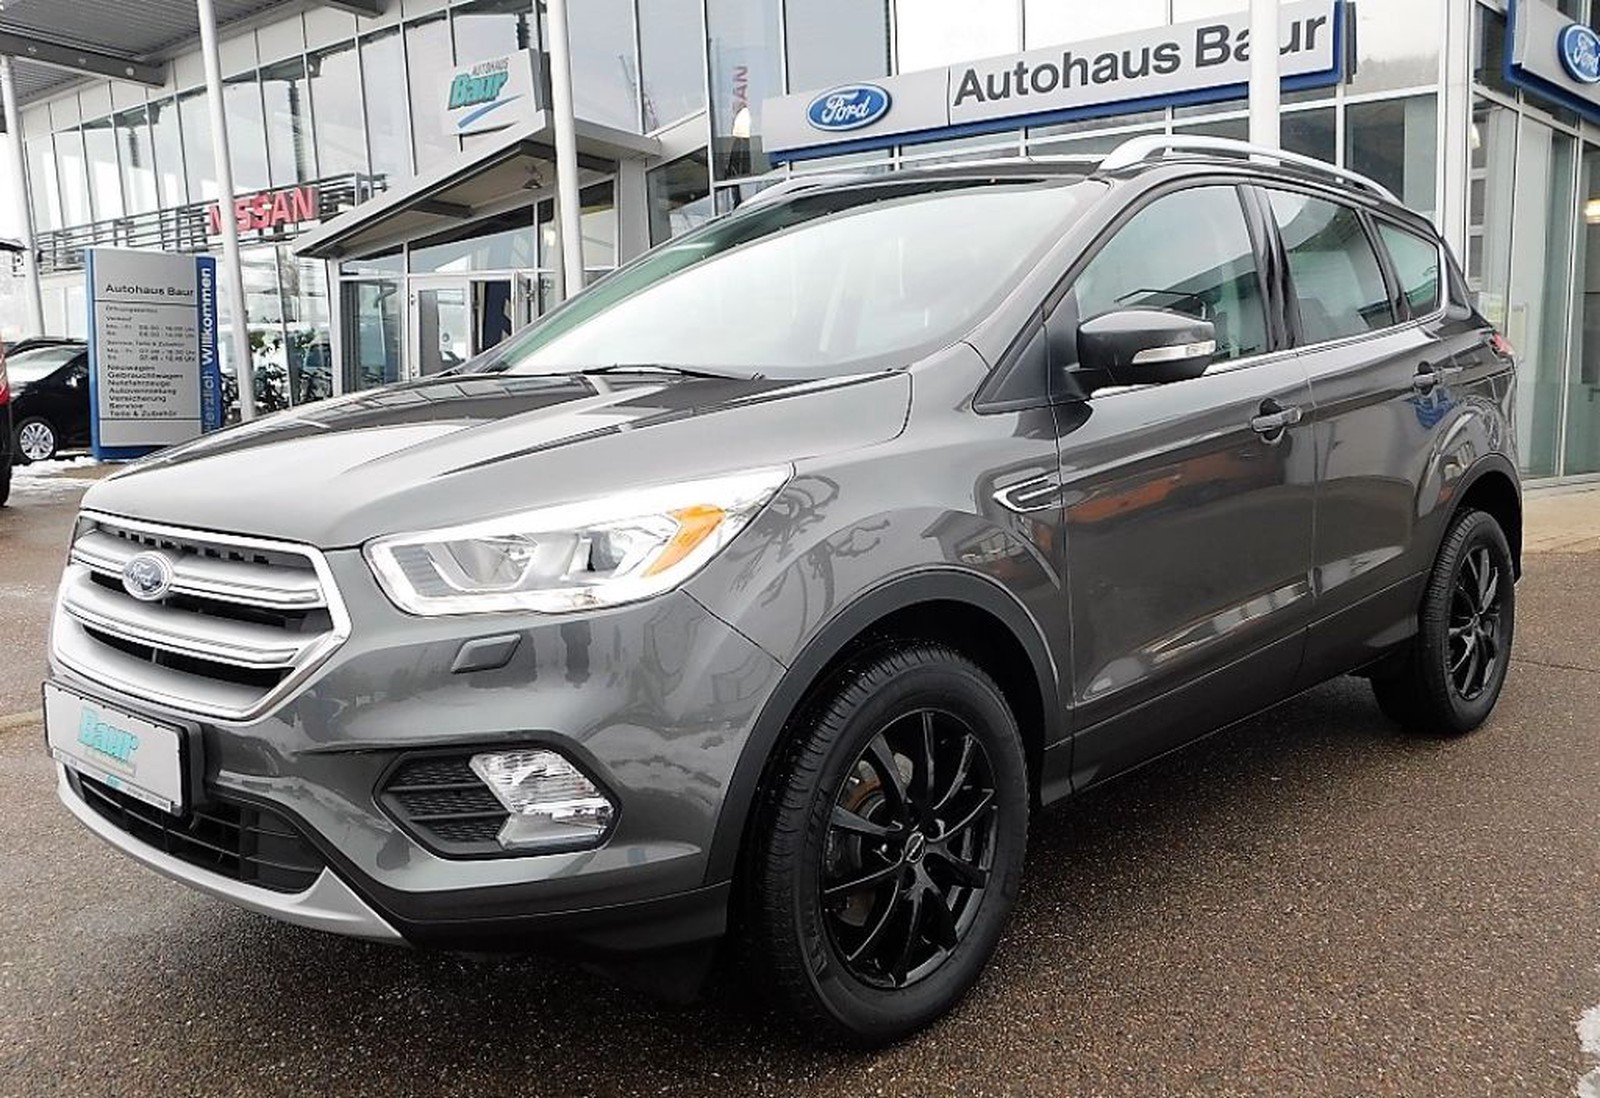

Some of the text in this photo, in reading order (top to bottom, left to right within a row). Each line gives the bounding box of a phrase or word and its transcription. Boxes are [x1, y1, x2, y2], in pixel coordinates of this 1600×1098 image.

[448, 72, 508, 110] Baur
[953, 42, 1181, 106] Autohaus
[208, 187, 314, 234] NSSAN
[106, 284, 194, 296] Autohaus Baur
[201, 267, 213, 365] Willkommen
[107, 364, 155, 372] Neuwagen
[107, 371, 183, 379] Gebrauchtwagen
[78, 706, 138, 763] Baur
